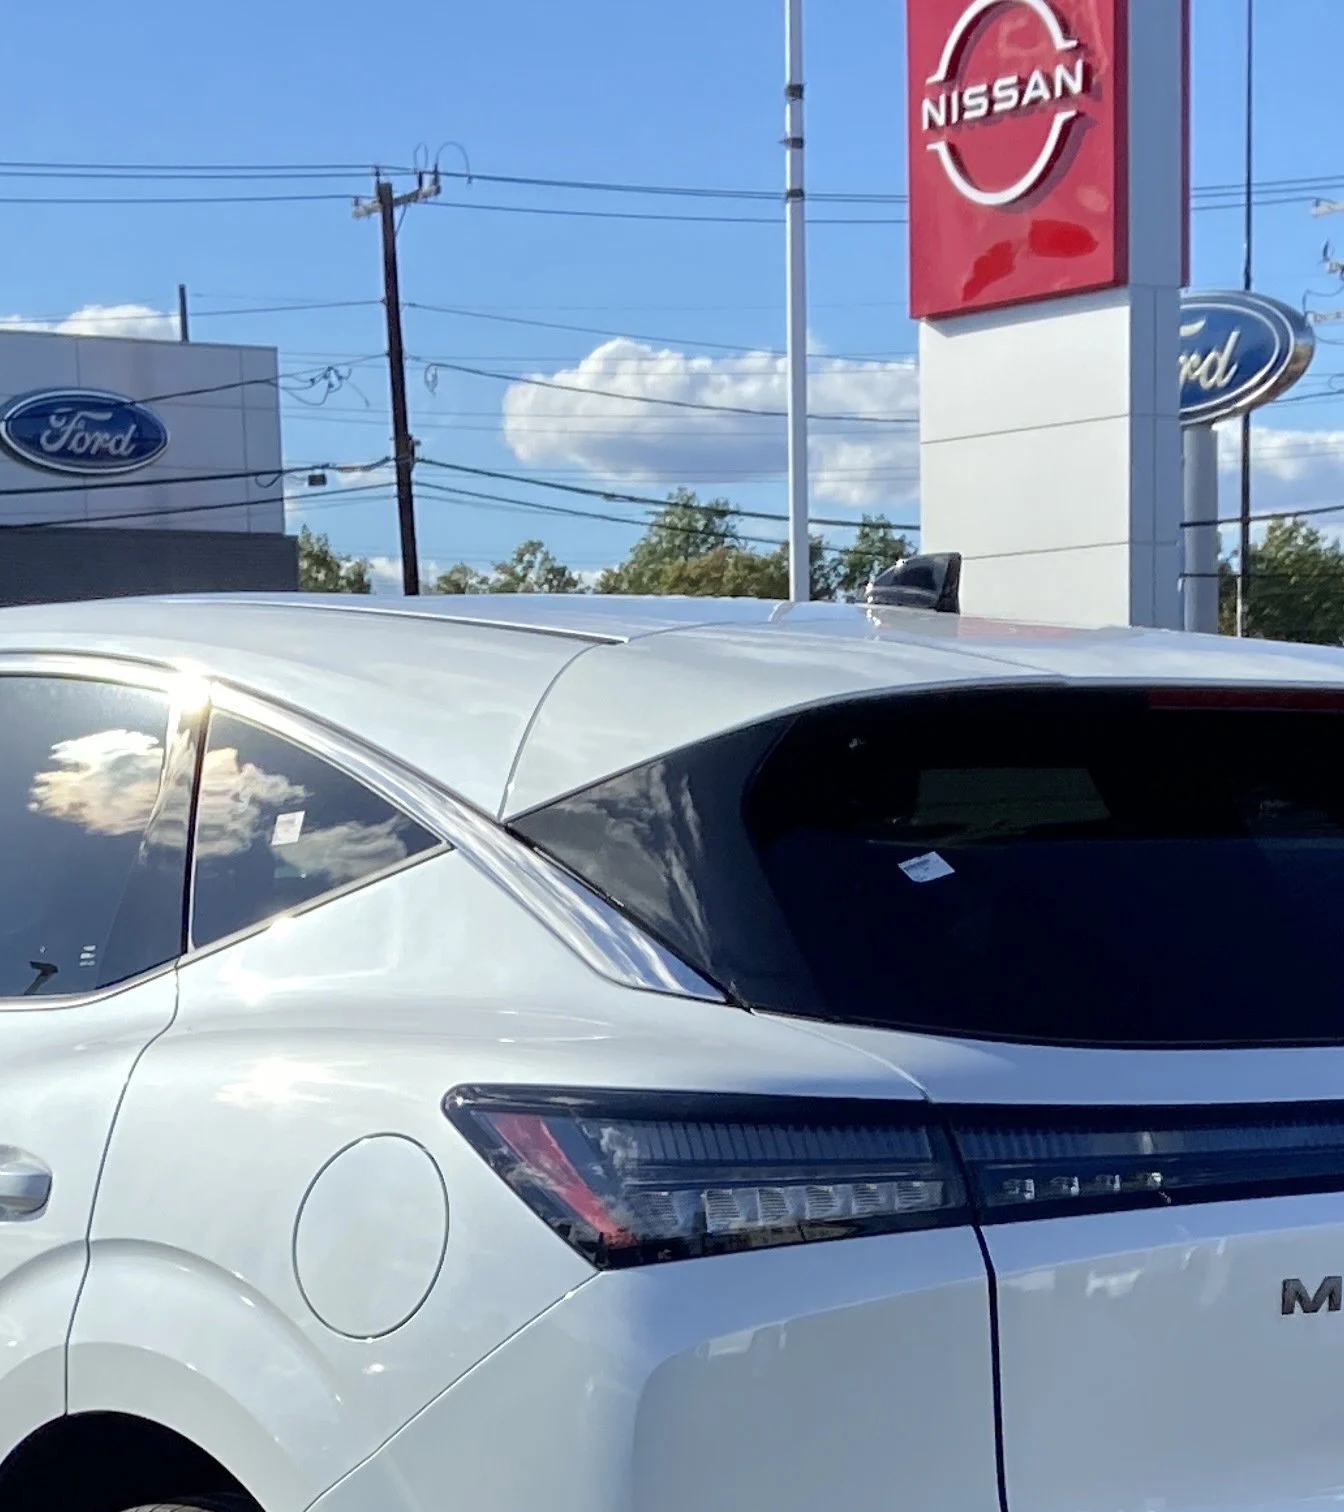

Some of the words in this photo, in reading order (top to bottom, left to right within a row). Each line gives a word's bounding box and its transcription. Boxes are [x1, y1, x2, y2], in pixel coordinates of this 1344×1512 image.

[921, 57, 1084, 131] NISSAN
[1178, 316, 1242, 391] rd
[39, 408, 137, 457] Ford
